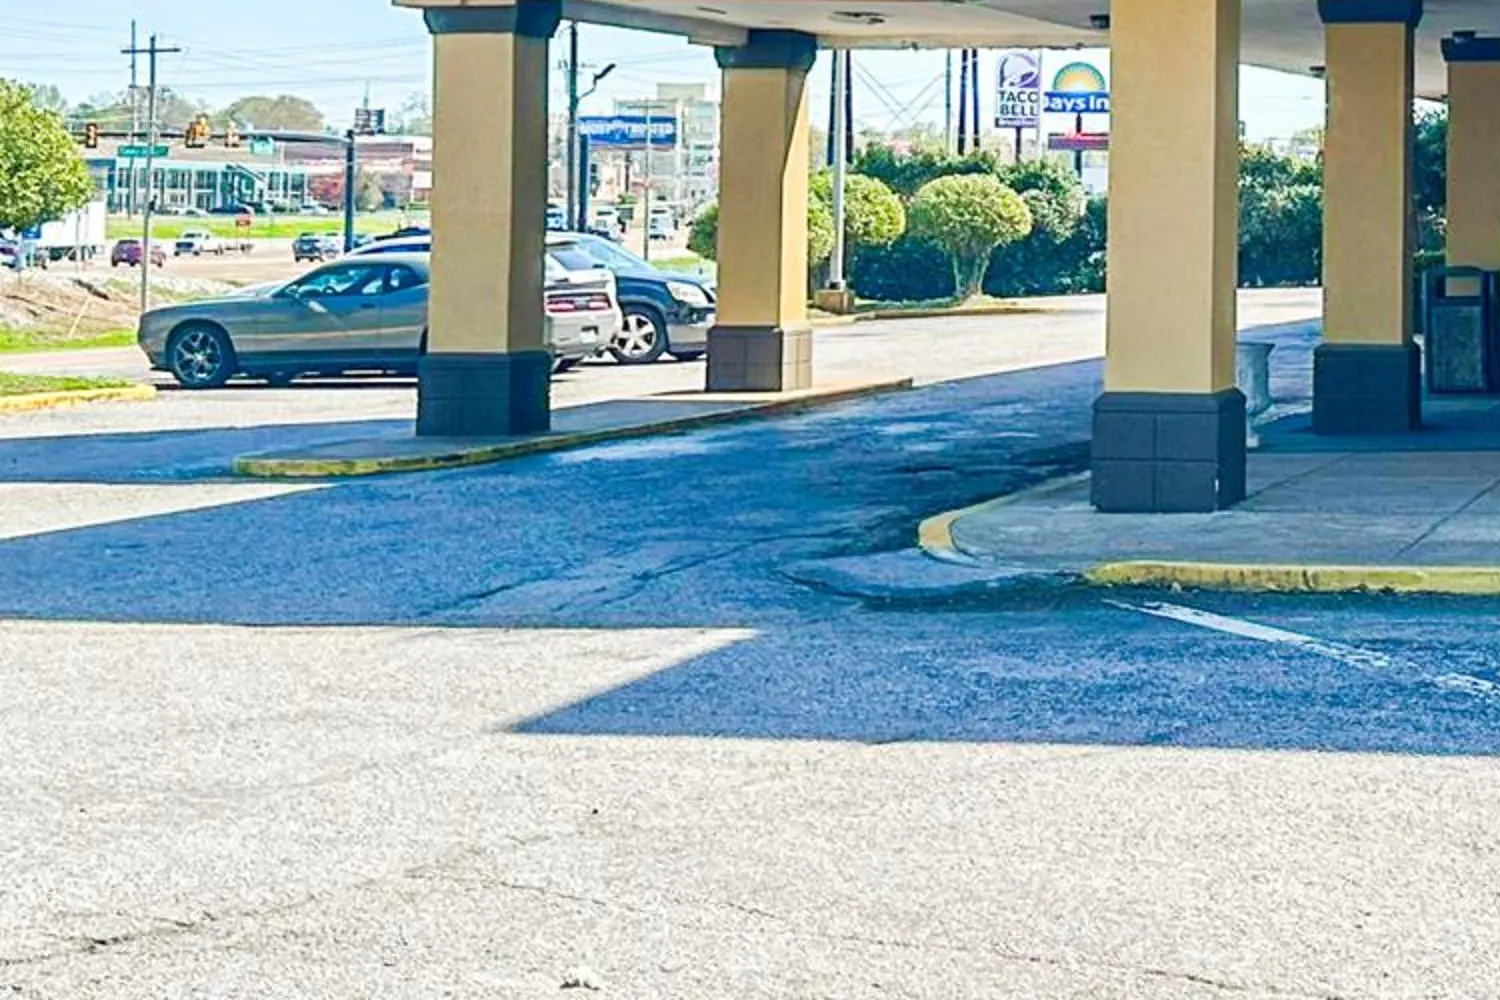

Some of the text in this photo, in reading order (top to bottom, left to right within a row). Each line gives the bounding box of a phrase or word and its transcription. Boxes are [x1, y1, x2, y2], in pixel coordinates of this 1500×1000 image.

[999, 91, 1040, 103] TACO
[1089, 95, 1110, 110] In
[1000, 104, 1039, 116] BELL
